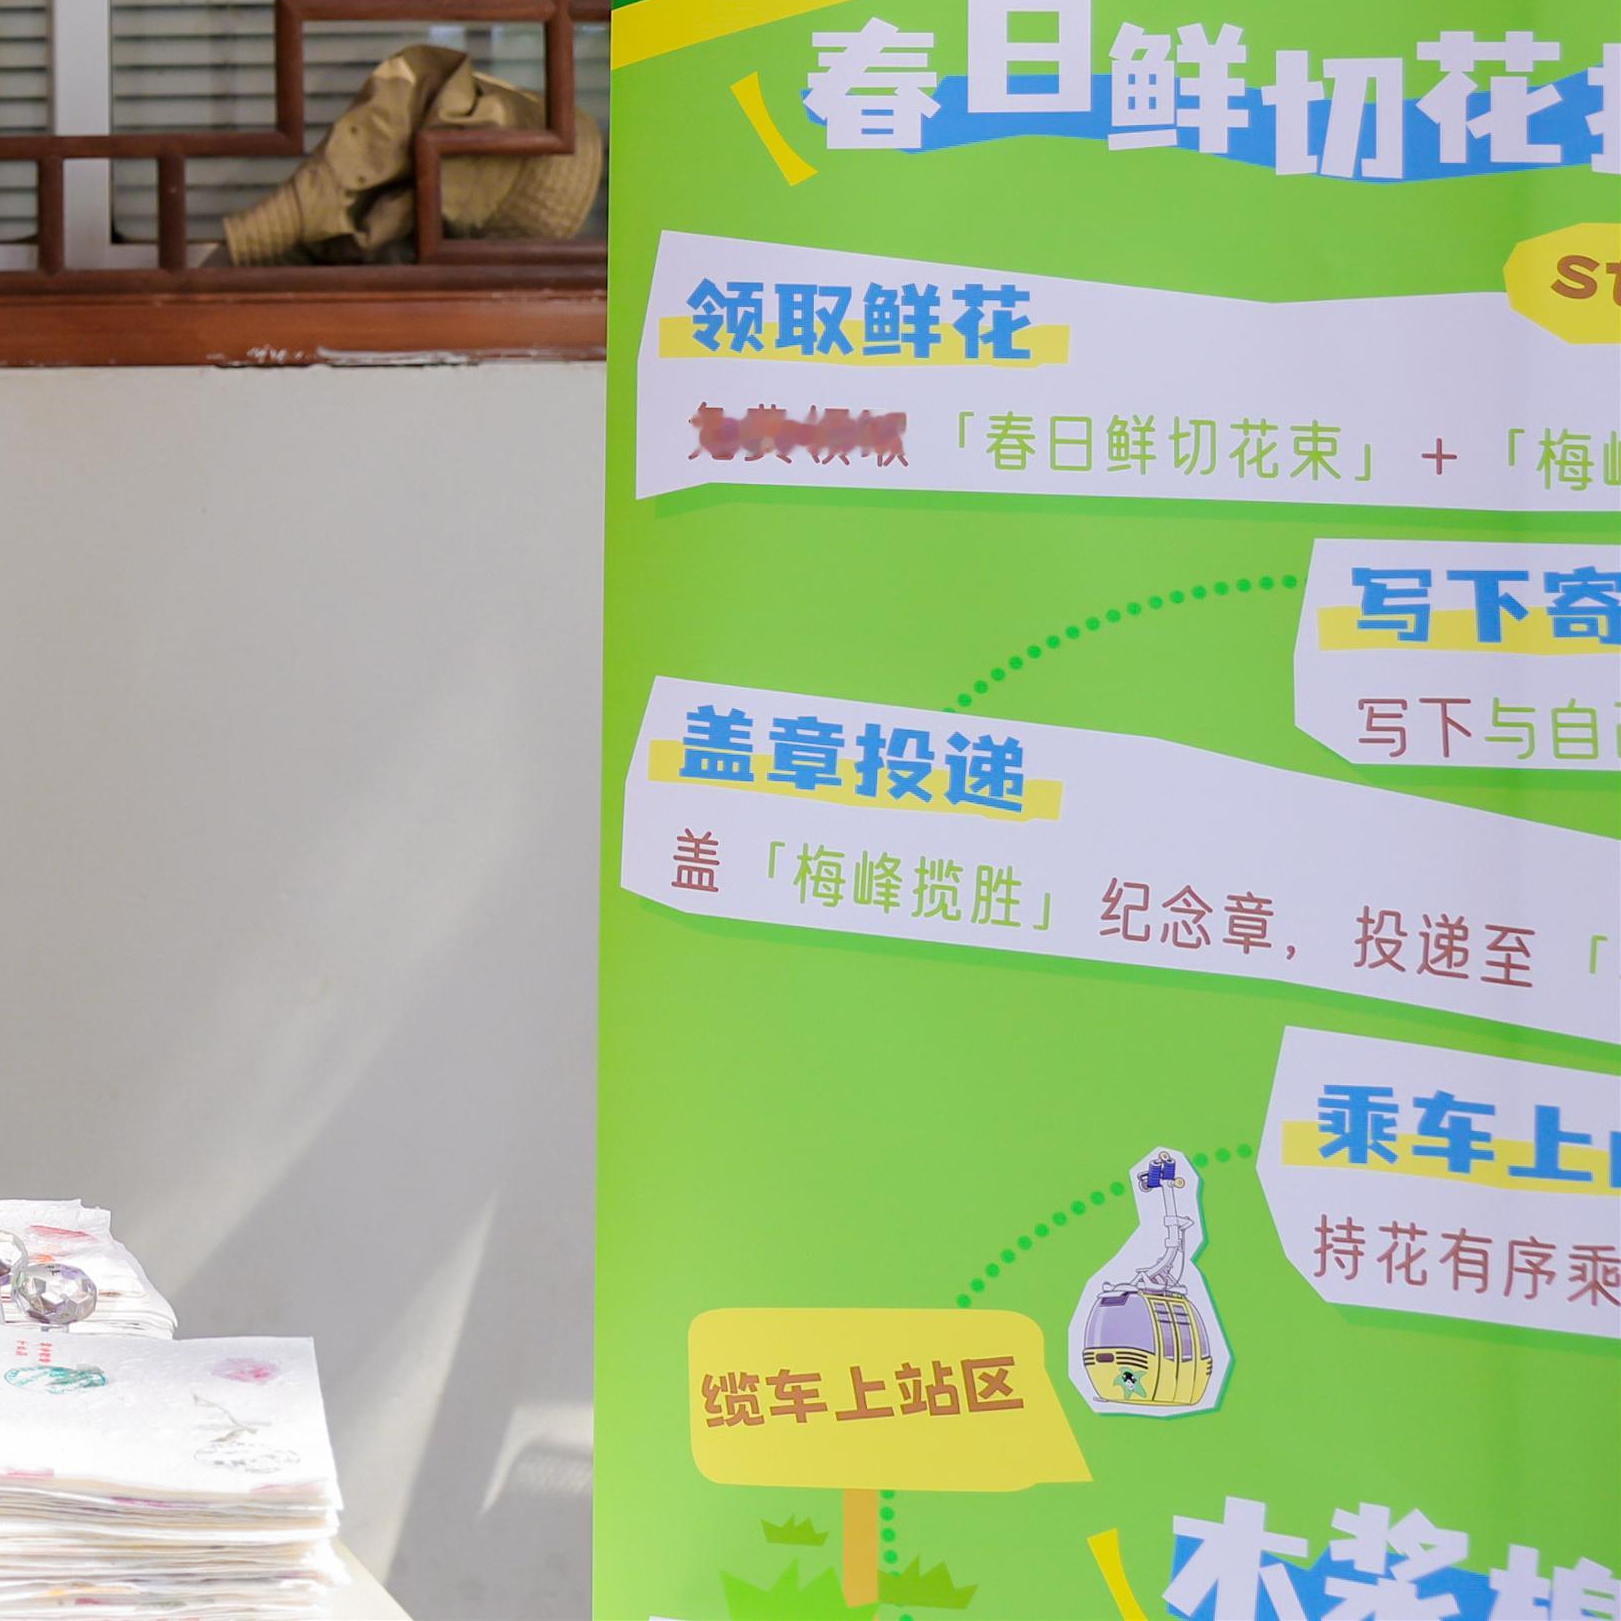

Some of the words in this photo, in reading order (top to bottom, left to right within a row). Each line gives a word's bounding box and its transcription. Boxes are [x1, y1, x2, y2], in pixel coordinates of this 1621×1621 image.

[686, 278, 1033, 360] 领取鲜花
[1351, 566, 1621, 646] 写下寄
[679, 704, 1025, 813] 盖章投递
[1357, 695, 1621, 760] 写下与自
[1317, 1085, 1621, 1191] 乘车上
[1313, 1213, 1621, 1307] 持花有序乘
[701, 1355, 1024, 1427] 缆车上站区
